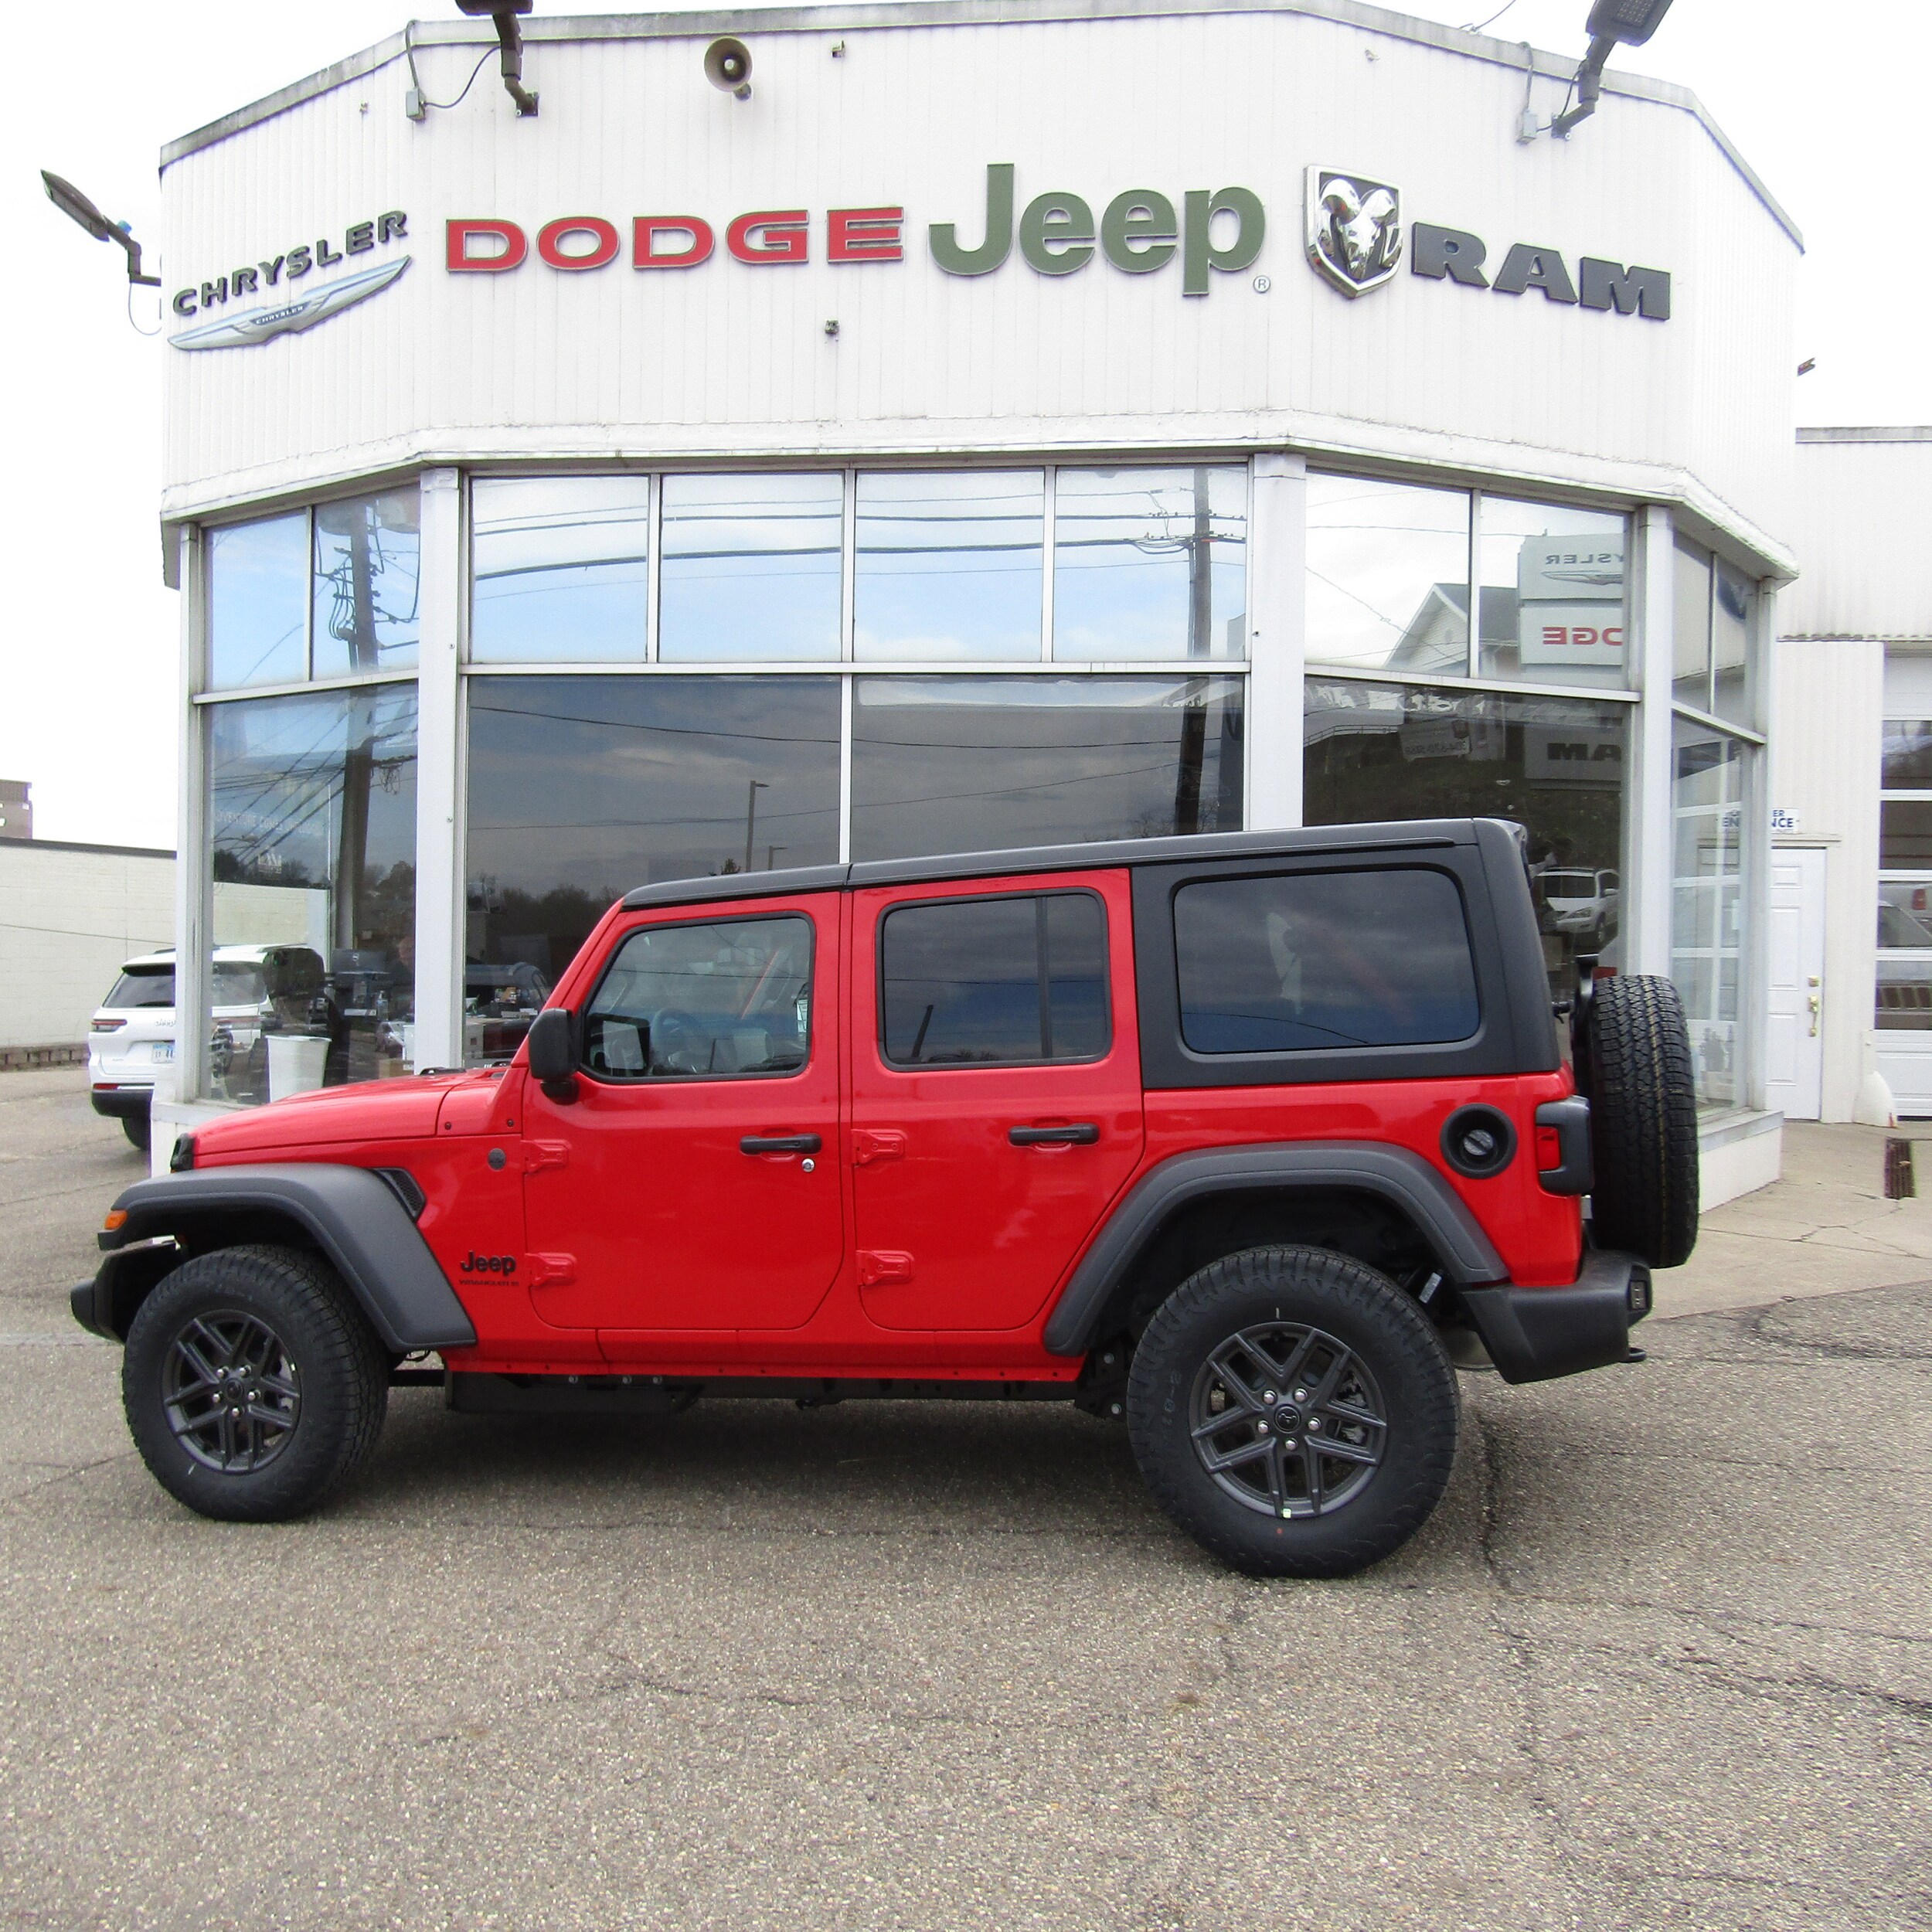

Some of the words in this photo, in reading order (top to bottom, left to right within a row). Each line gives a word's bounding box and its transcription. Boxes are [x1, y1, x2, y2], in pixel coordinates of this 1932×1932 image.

[172, 209, 409, 316] CHRYSLER
[446, 206, 904, 274] DODGE
[928, 162, 1266, 297] Jeep
[1411, 221, 1673, 321] RAM
[460, 1250, 517, 1277] Jeep
